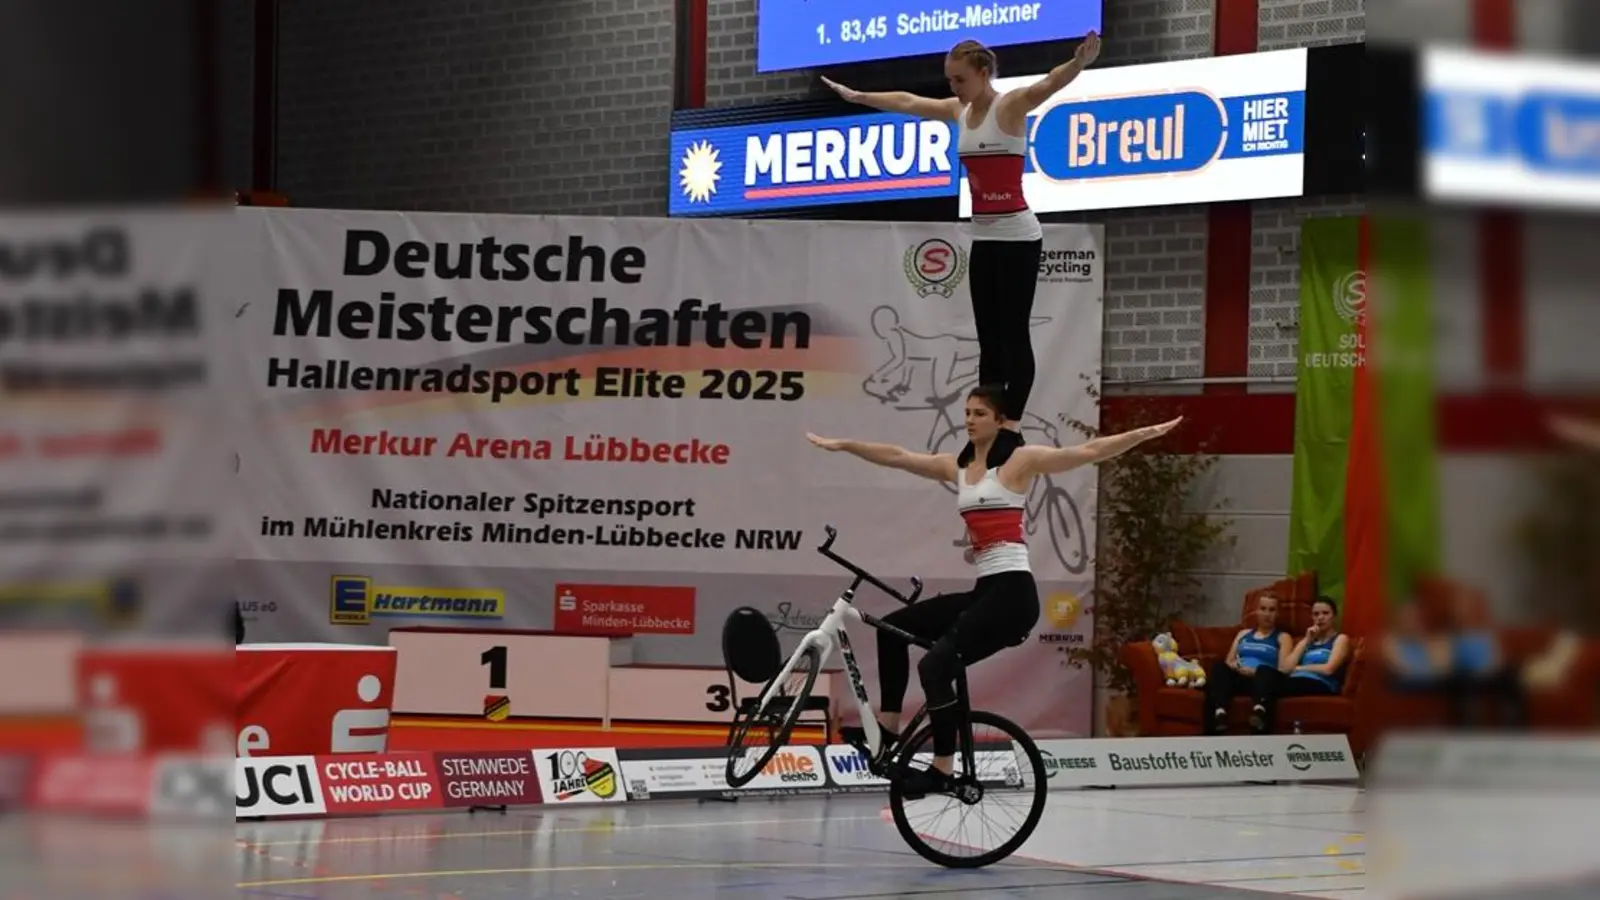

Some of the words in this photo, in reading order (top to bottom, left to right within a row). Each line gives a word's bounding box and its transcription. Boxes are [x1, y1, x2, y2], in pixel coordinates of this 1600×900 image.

[817, 24, 831, 45] 1.
[840, 16, 887, 44] 83,45
[896, 2, 1041, 36] Schütz-Meixner
[1243, 98, 1288, 120] HIER
[1068, 104, 1185, 168] Breul
[1243, 119, 1288, 141] MIET
[744, 120, 951, 186] MERKUR
[343, 229, 646, 283] Deutsche
[272, 288, 812, 349] Meisterschaften
[266, 358, 582, 402] Hallenradsport
[595, 366, 685, 399] Elite
[699, 369, 805, 401] 2025
[311, 428, 437, 458] Merkur
[447, 432, 552, 461] Arena
[565, 433, 731, 465] Lübbecke
[371, 488, 515, 513] Nationaler
[523, 492, 695, 519] Spitzensport
[261, 517, 294, 537] im
[303, 517, 473, 544] Mühlenkreis
[482, 522, 726, 549] Minden-Lübbecke
[734, 528, 803, 551] NRW
[374, 593, 498, 613] Hartmann
[582, 600, 645, 615] Sparkasse
[582, 615, 692, 630] Minden-Lübbecke
[480, 646, 509, 690] 1
[706, 684, 731, 712] 3
[441, 758, 530, 777] STEMWEDE
[1059, 757, 1097, 769] REESE
[1109, 751, 1189, 771] Baustoffe
[1191, 751, 1212, 769] für
[1215, 750, 1275, 768] Meister
[1312, 751, 1345, 762] REESE
[325, 760, 428, 781] CYCLE-BALL
[781, 772, 819, 782] elektro
[329, 784, 394, 804] WORLD
[398, 782, 432, 800] CUP
[447, 780, 525, 799] GERMANY
